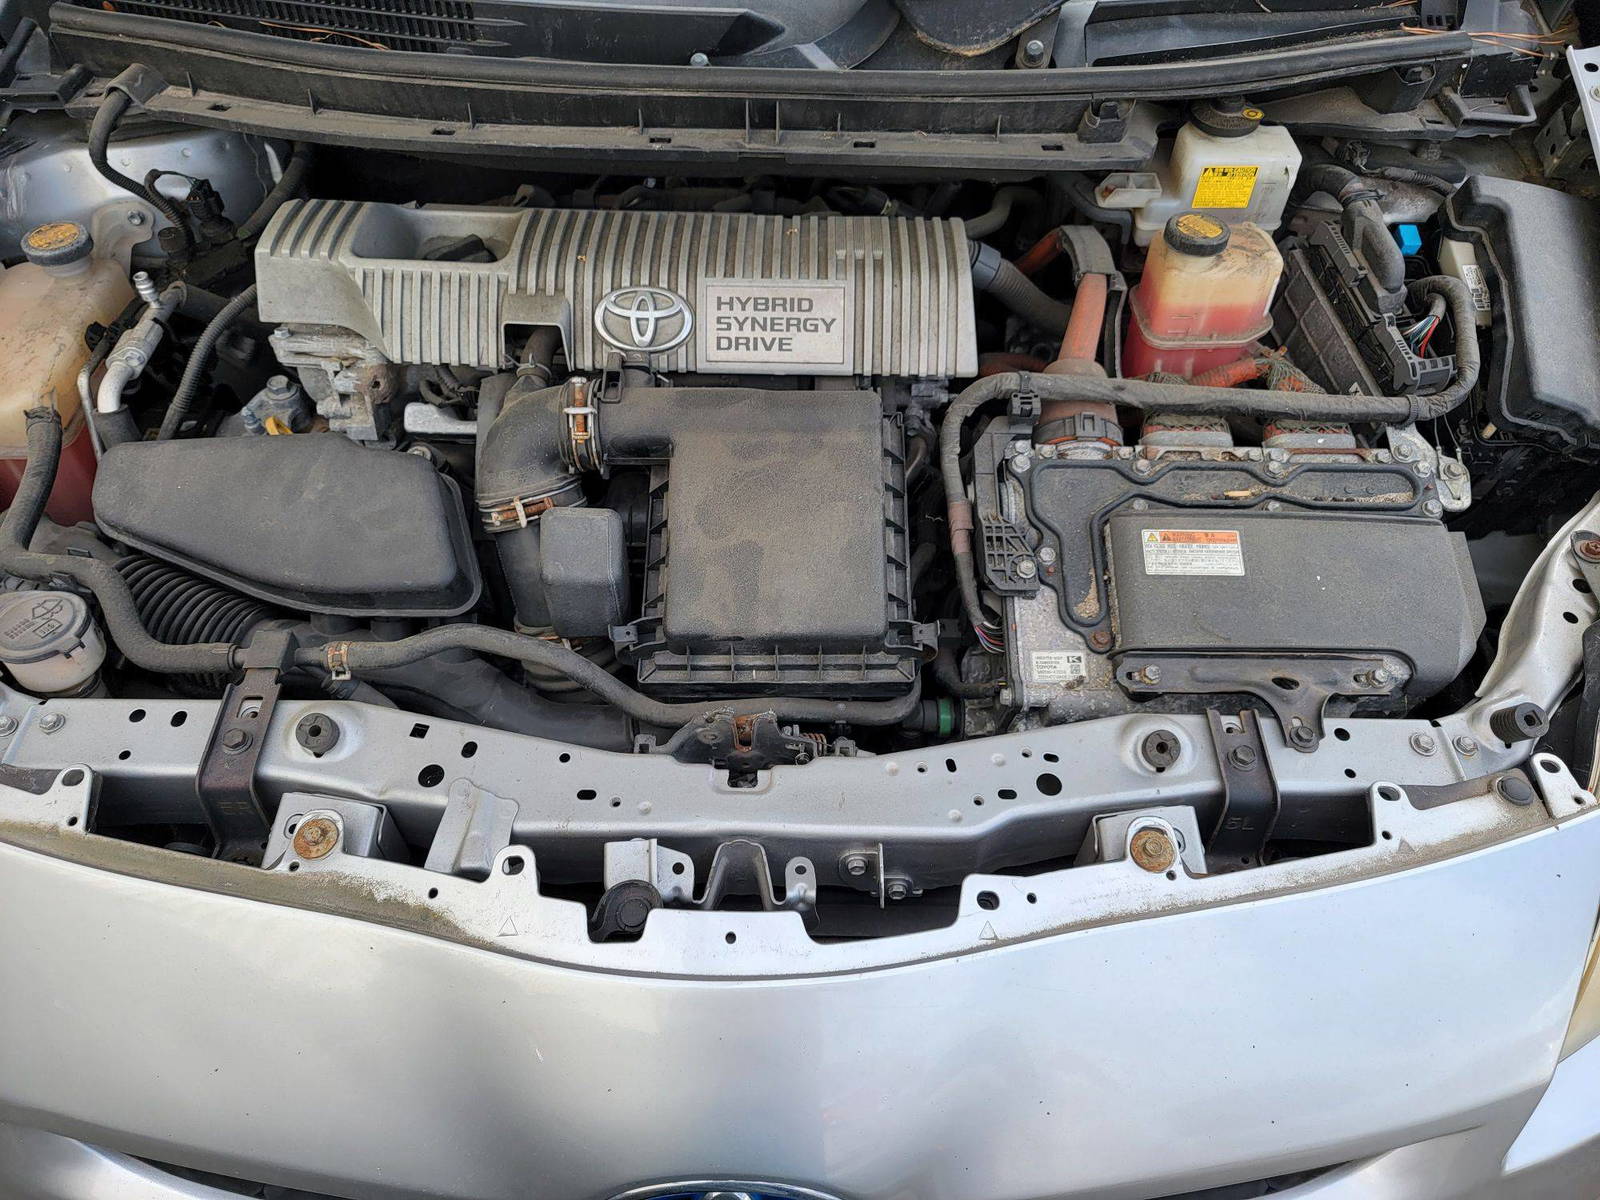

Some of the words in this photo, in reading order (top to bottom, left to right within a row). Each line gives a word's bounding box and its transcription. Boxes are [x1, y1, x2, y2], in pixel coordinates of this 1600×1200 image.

[716, 296, 814, 313] HYBRID
[716, 316, 837, 333] SYNERGY
[716, 336, 793, 352] DRIVE
